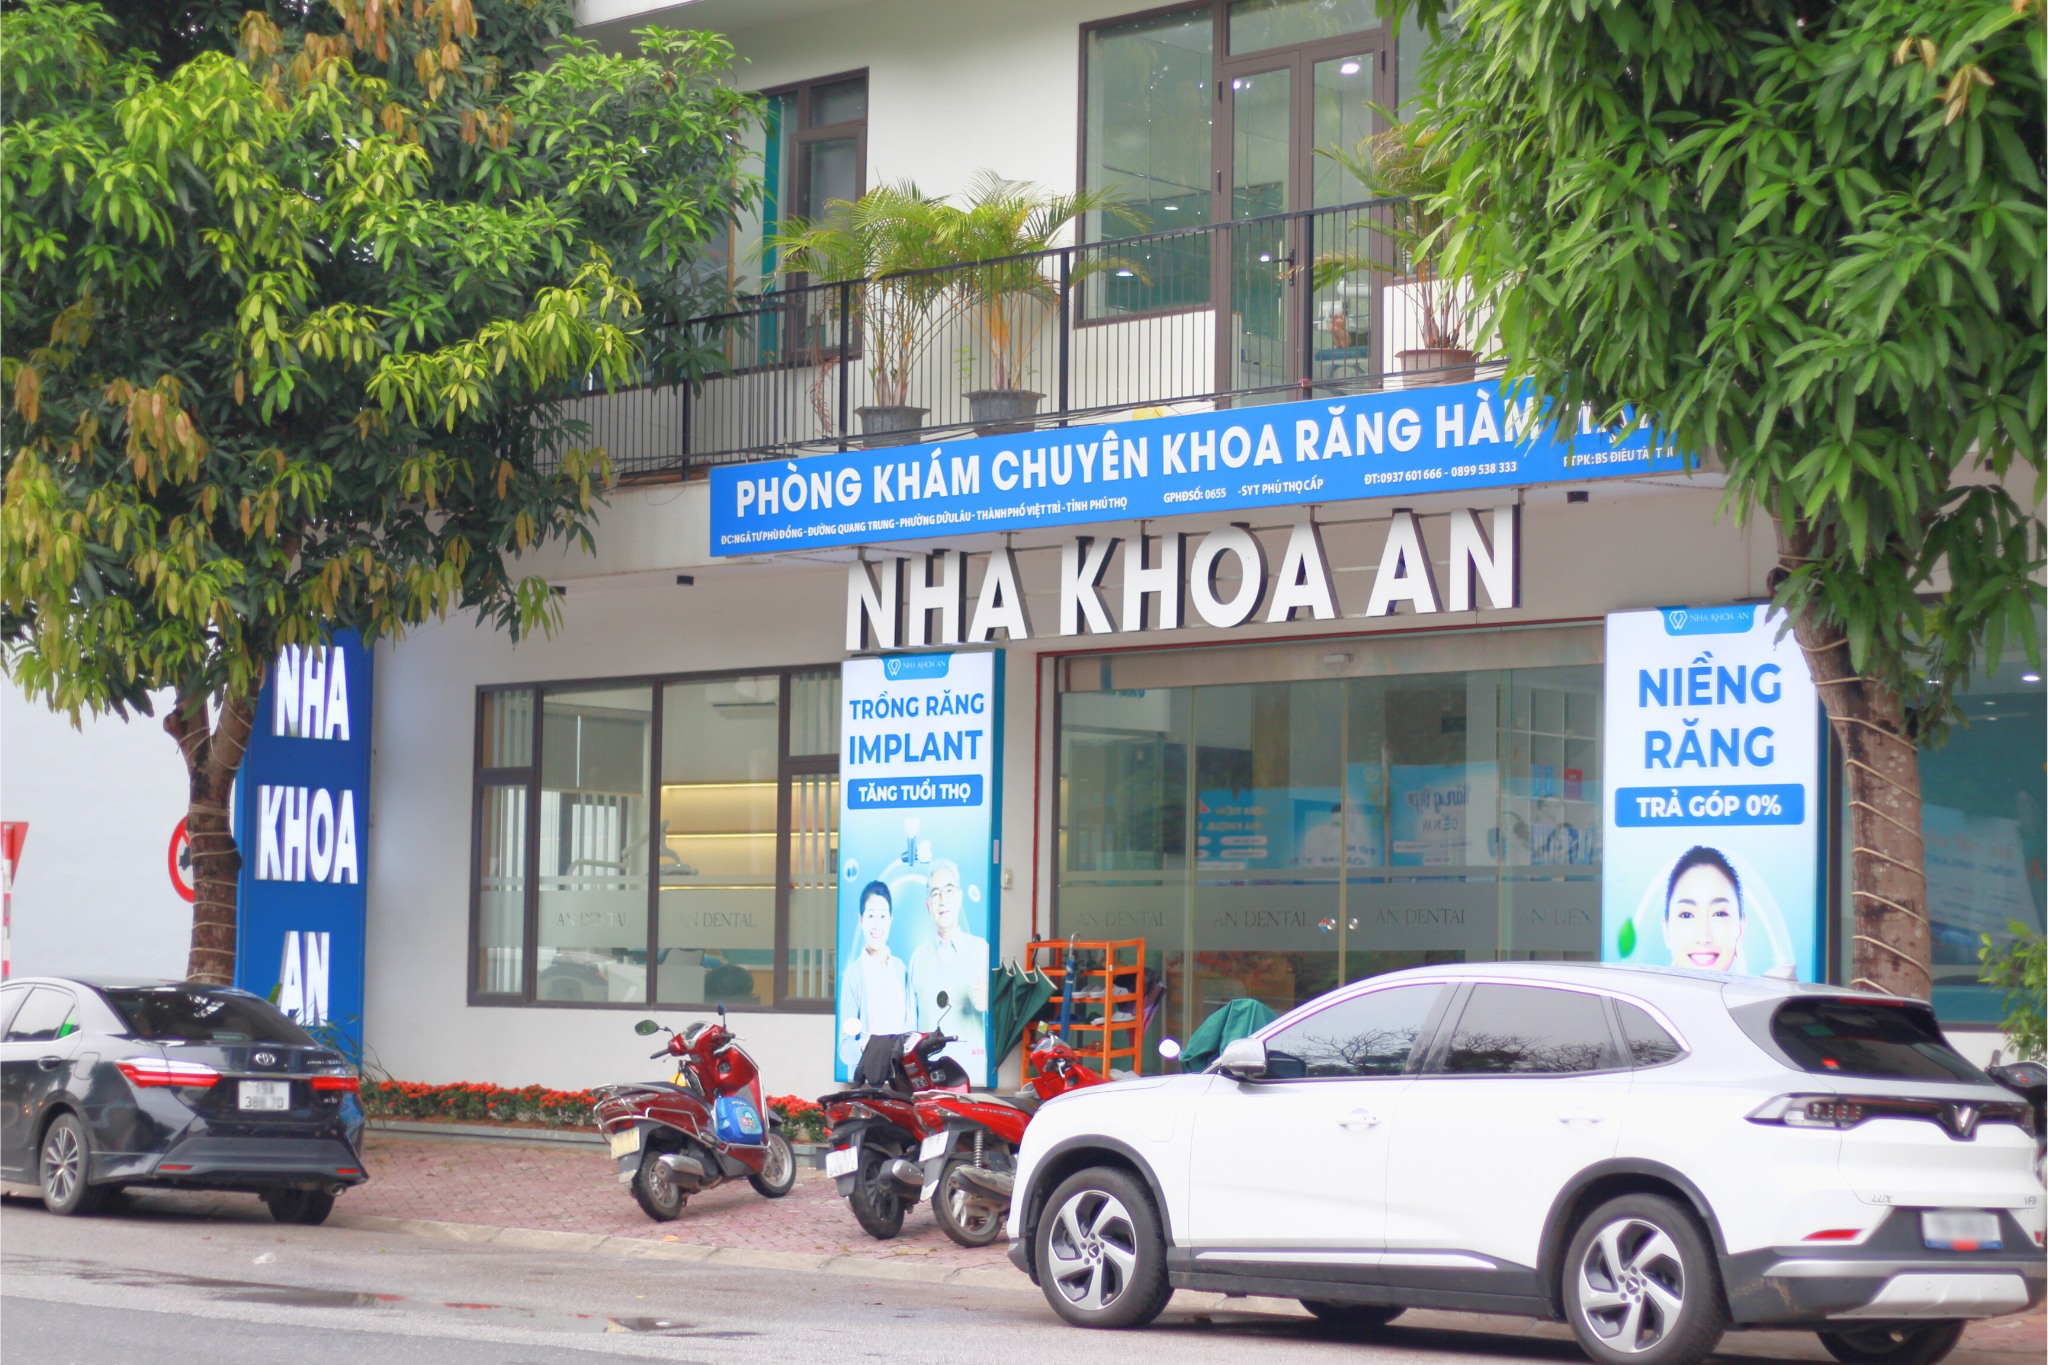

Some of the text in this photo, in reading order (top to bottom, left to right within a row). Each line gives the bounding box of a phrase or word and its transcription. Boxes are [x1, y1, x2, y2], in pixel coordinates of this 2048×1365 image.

[736, 461, 862, 518] PHÒNG
[873, 448, 980, 504] KHÁM
[991, 435, 1148, 491] CHUYÊN
[1162, 424, 1283, 475] KHOA
[1295, 405, 1422, 462] RĂNG
[1435, 388, 1539, 449] HÀM
[1424, 468, 1442, 480] 666
[1451, 465, 1476, 477] 0899
[1478, 463, 1496, 475] 538
[1499, 461, 1517, 473] 333
[1205, 488, 1226, 499] 0655
[838, 521, 866, 534] QUANG
[868, 519, 894, 531] TRUNG
[846, 504, 1516, 651] NHA KHOA AN
[1690, 611, 1749, 623] NHA KHOA AN
[274, 643, 351, 741] NHA
[1639, 651, 1782, 708] NIỀNG
[849, 689, 984, 720] TRỒNG RĂNG
[849, 730, 983, 765] IMPLANT
[1644, 717, 1775, 769] RĂNG
[858, 778, 971, 803] TĂNG TUỔI THỌ
[1636, 789, 1782, 818] TRẢ GÓP 0%
[255, 784, 359, 884] KHOA
[281, 930, 330, 1027] AN
